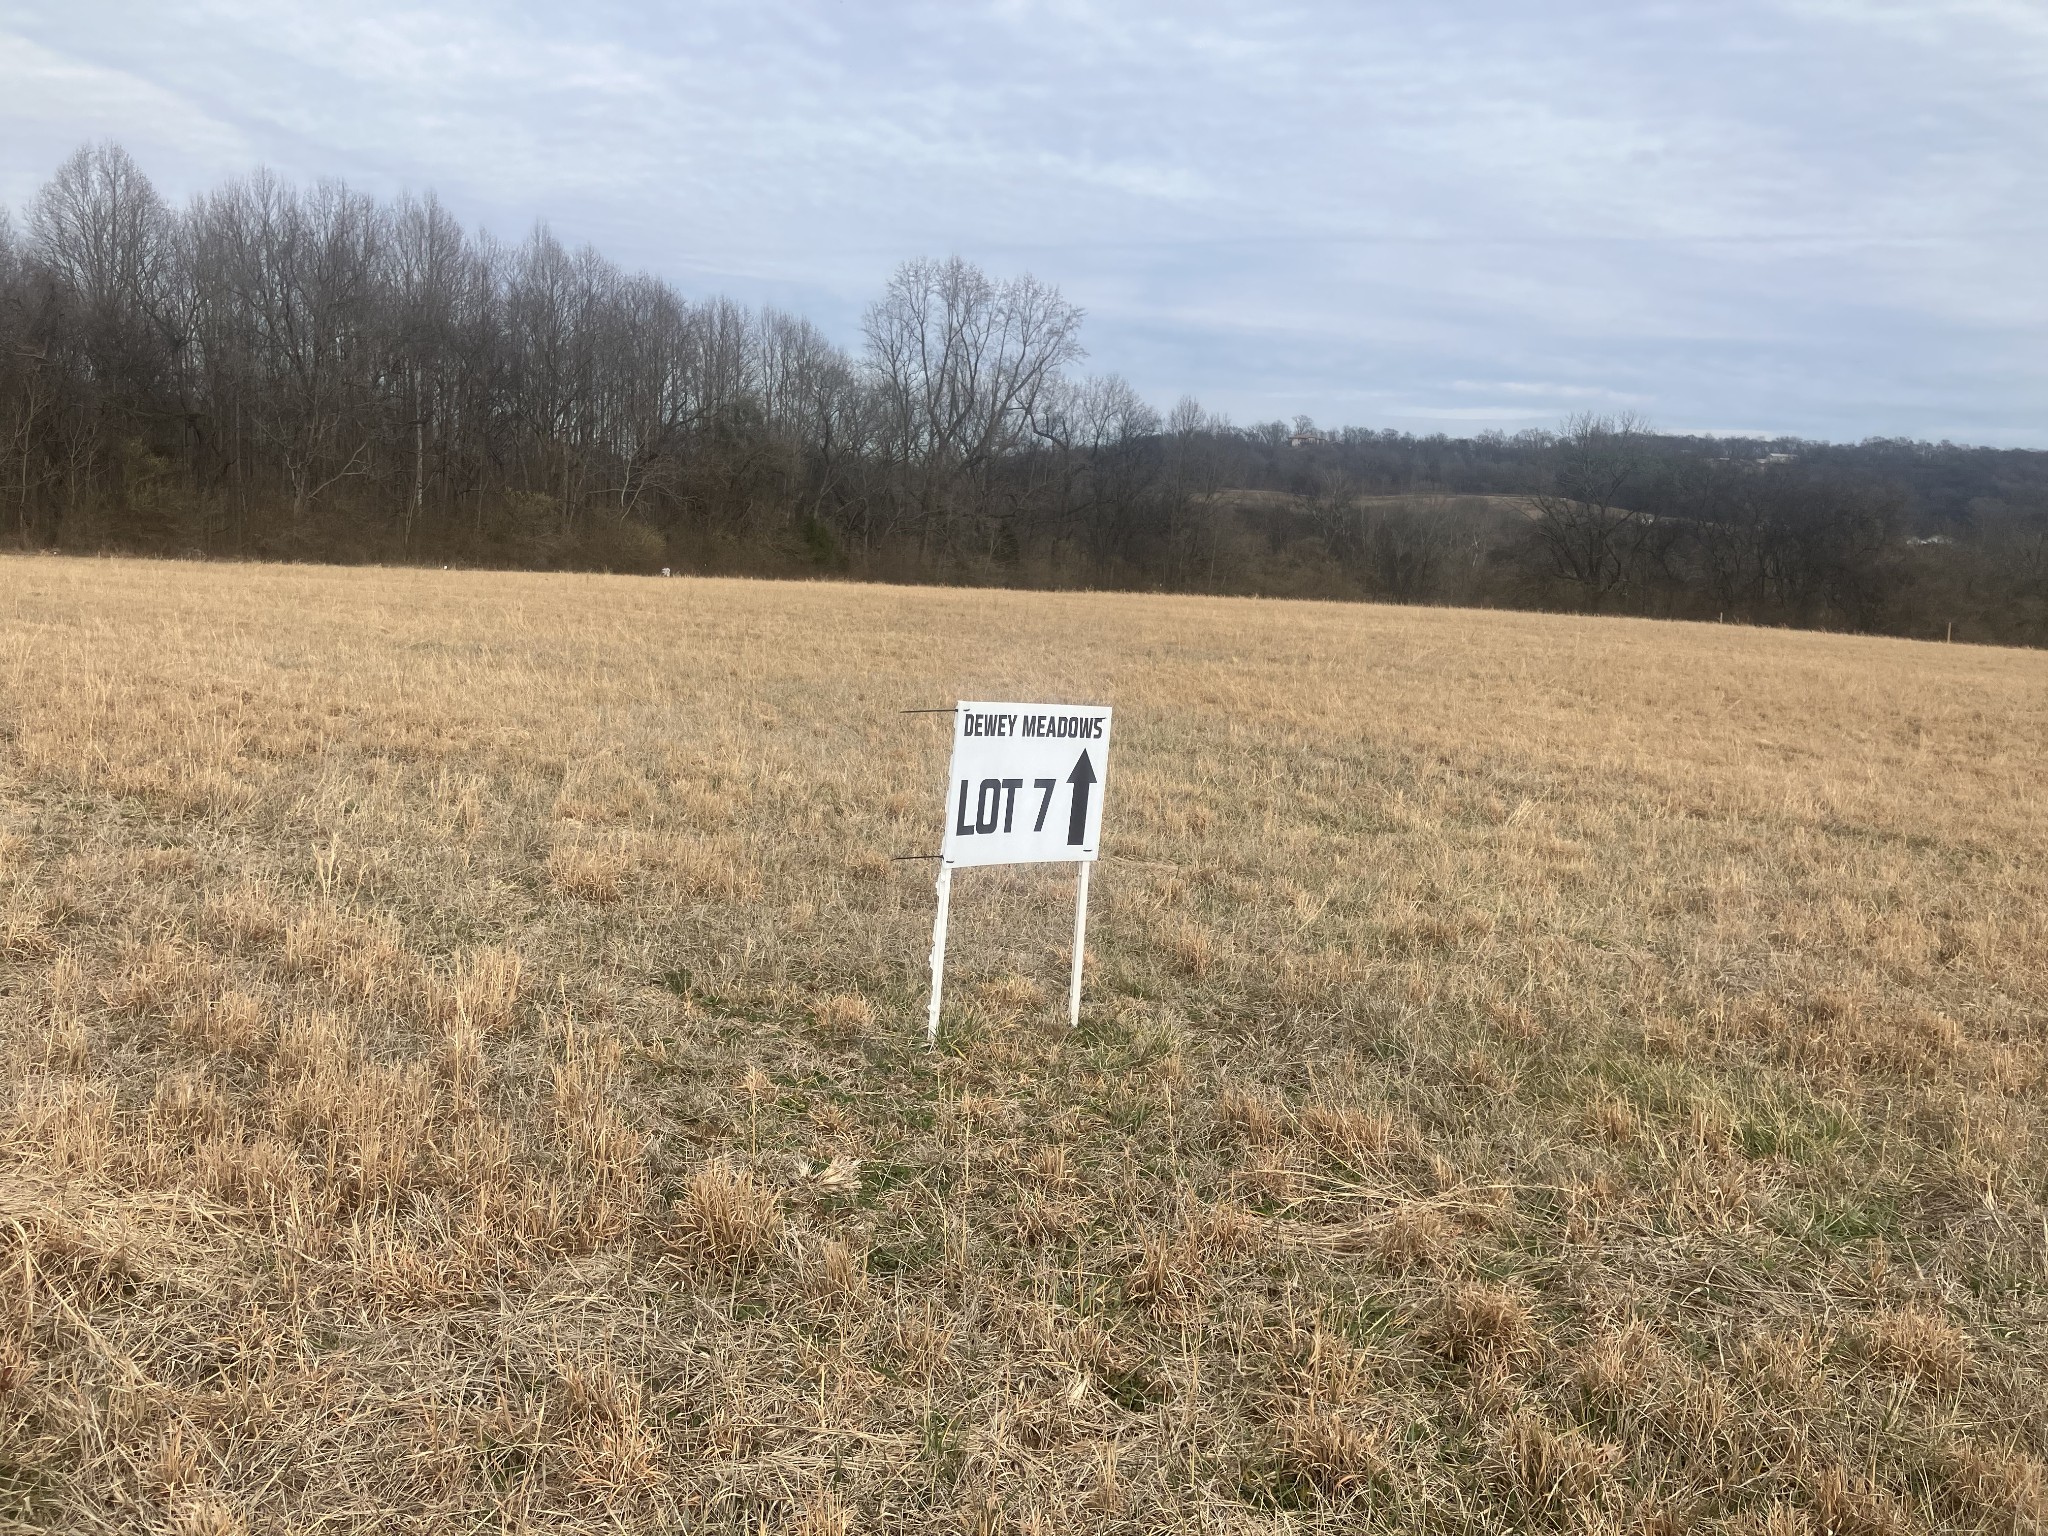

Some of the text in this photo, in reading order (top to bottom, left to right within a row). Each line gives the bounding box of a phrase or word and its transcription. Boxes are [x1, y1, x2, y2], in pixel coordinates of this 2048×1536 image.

[963, 713, 1104, 739] DEWEY MEADOWS
[955, 778, 1057, 836] LOT 7
